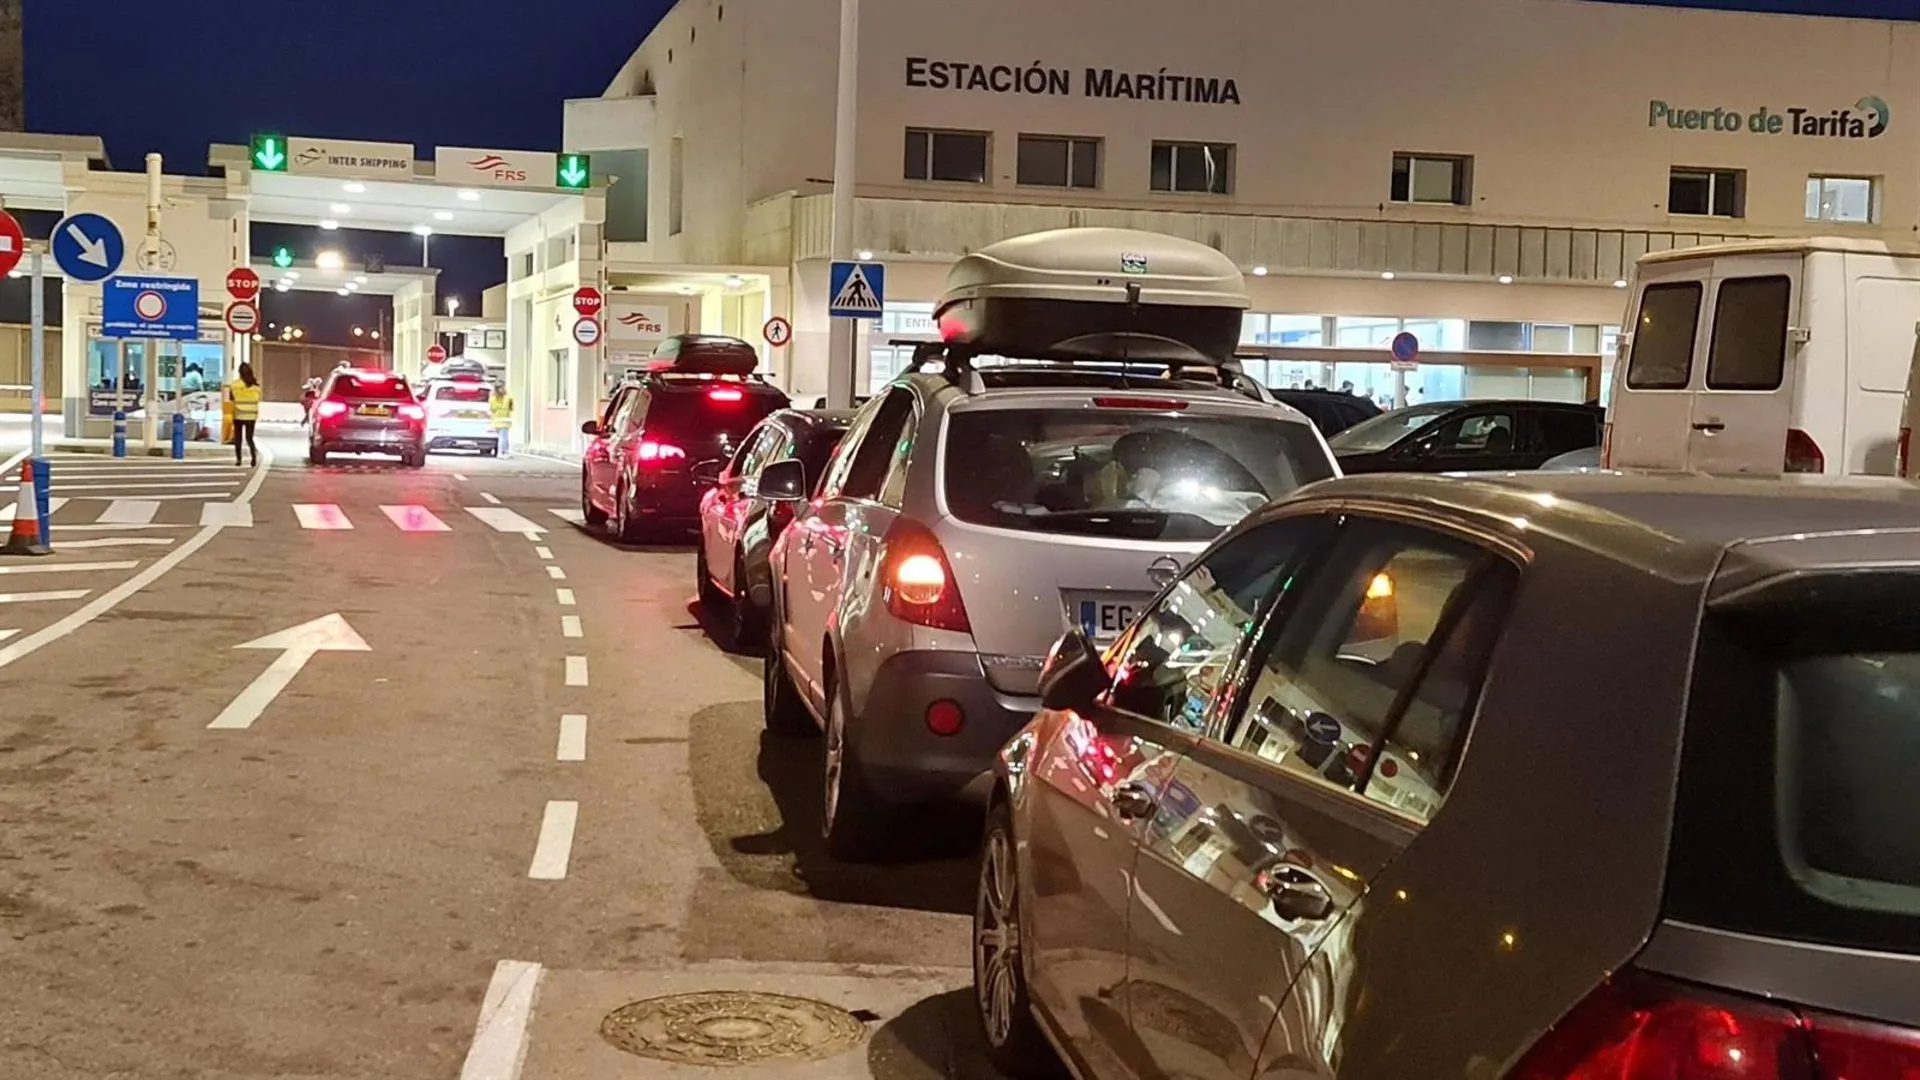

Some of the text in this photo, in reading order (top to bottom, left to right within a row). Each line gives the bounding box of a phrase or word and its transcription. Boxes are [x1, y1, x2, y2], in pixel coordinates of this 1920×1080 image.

[906, 57, 1240, 105] ESTACIÓN MARÍTIMA
[1648, 100, 1864, 138] Puerto de Tarifa
[328, 155, 407, 169] INTER SHIPPING
[494, 169, 527, 181] FRS
[115, 279, 191, 292] Zona restringida
[227, 279, 259, 288] STOP
[575, 297, 601, 306] STOP
[637, 323, 661, 333] FRS
